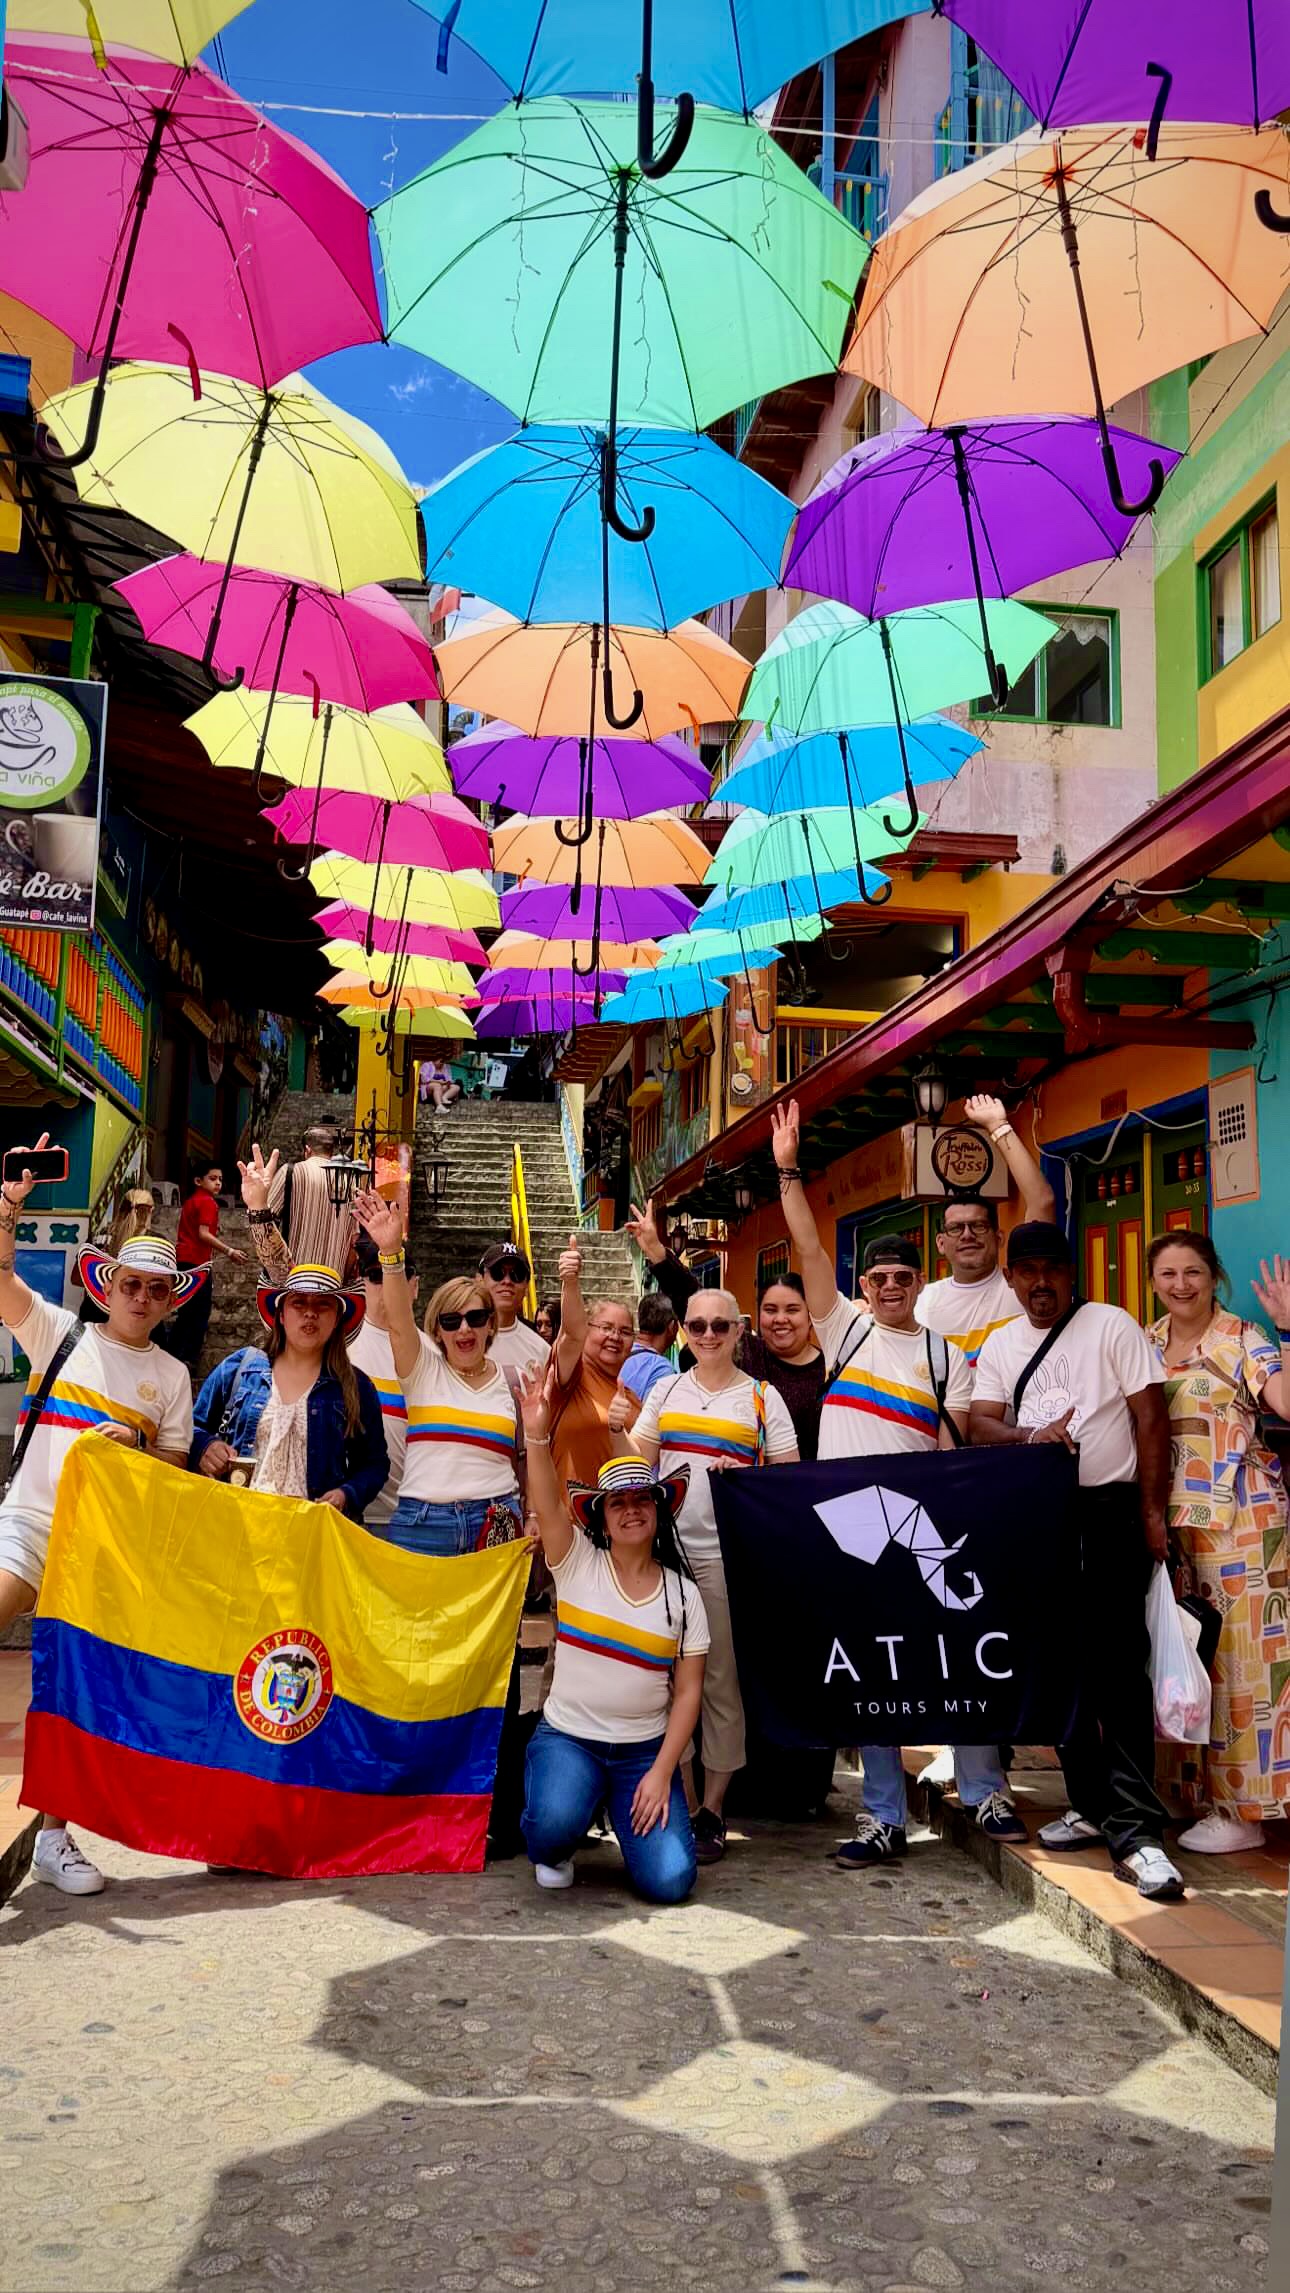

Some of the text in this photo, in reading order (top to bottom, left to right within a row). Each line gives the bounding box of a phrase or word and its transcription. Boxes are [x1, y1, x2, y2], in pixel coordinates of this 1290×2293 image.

[17, 771, 56, 786] viña
[502, 1242, 517, 1254] NY
[249, 1631, 330, 1676] REPUBLICA
[823, 1631, 1014, 1684] ATIC
[240, 1691, 325, 1739] DE COLOMBIA
[853, 1700, 988, 1715] TOURS MTY
